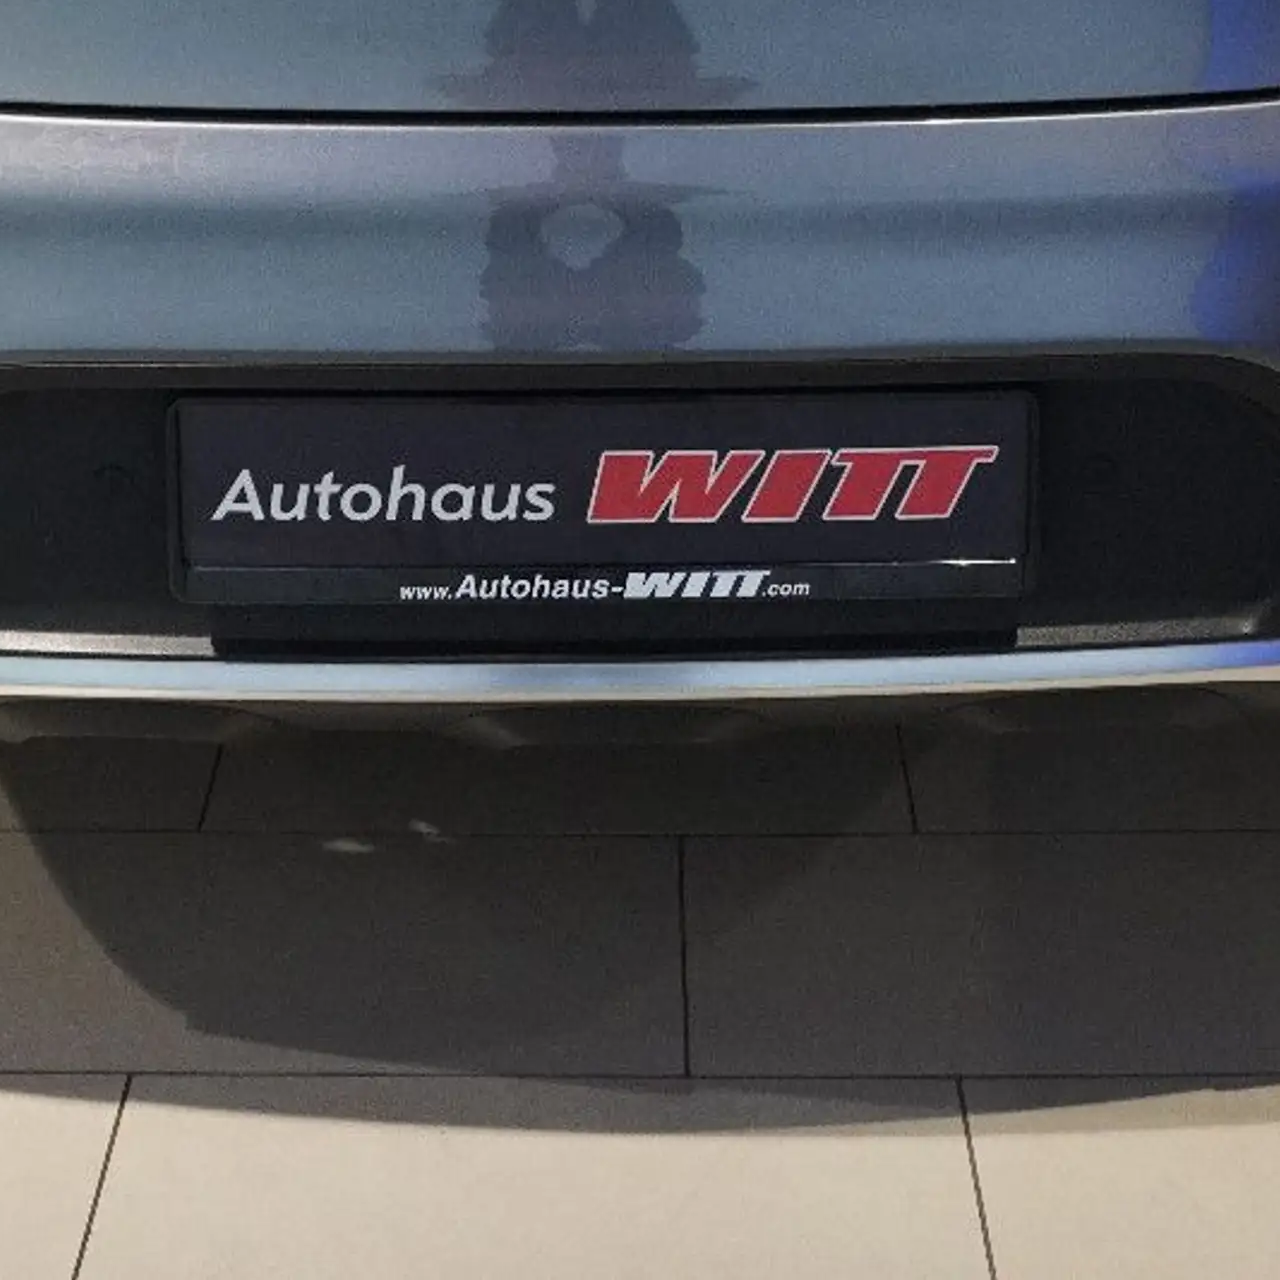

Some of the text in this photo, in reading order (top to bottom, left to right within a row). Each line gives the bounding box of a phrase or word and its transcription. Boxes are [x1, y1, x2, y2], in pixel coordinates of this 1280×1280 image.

[211, 445, 999, 523] Autohaus WITT
[399, 569, 810, 600] www.Autohaus-WITT.com
